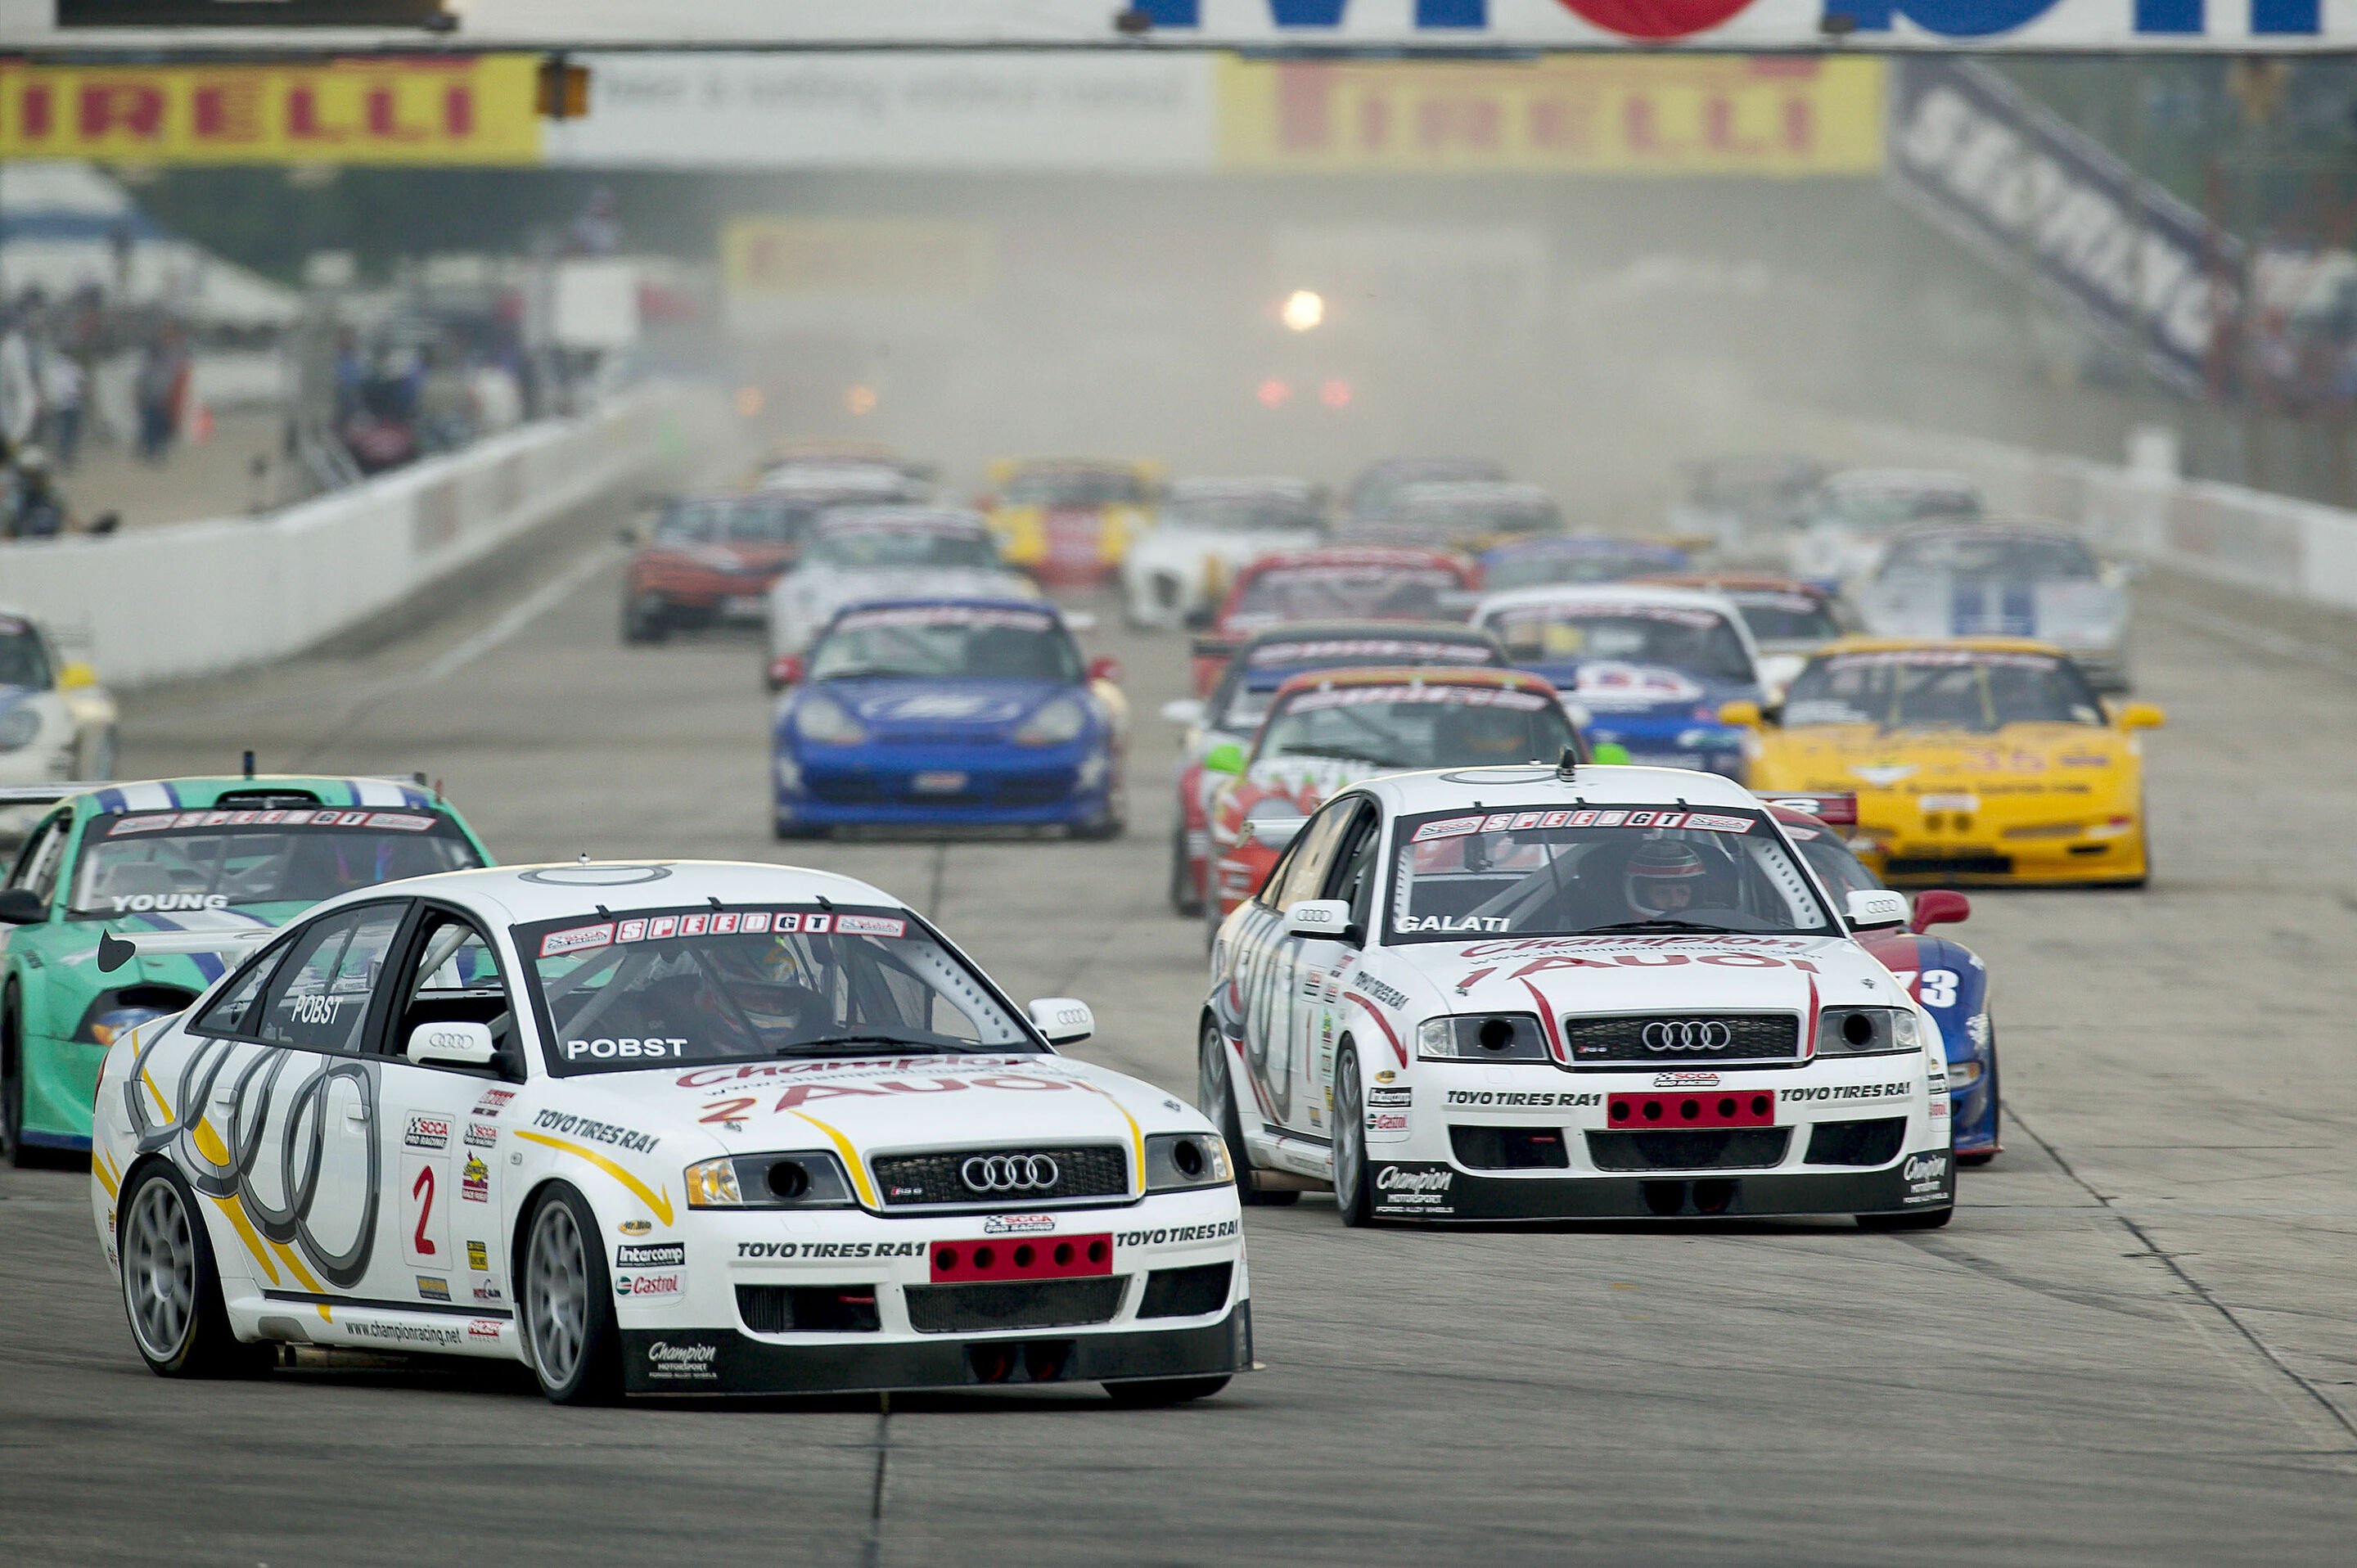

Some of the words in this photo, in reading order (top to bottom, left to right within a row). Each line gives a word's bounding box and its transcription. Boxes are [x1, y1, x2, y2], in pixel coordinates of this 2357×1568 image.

[1485, 811, 1626, 831] SPEED
[1631, 813, 1680, 827] GT
[110, 894, 230, 912] YOUNG
[619, 912, 769, 942] SPEED
[778, 916, 827, 930] GT
[1395, 915, 1510, 934] GALATI
[292, 994, 345, 1025] POBST
[566, 1037, 689, 1061] POBST
[1447, 1090, 1492, 1105] TOYO
[1496, 1092, 1554, 1106] TIRES
[1557, 1093, 1602, 1106] RA1
[1780, 1086, 1829, 1102] TOYO
[1833, 1083, 1881, 1099] TIRES
[1884, 1081, 1911, 1096] RA1
[698, 1097, 758, 1124] 2
[420, 1120, 448, 1136] SCCA
[533, 1108, 578, 1133] TOYO
[573, 1117, 625, 1144] TIRES
[620, 1130, 660, 1154] RA1
[1376, 1165, 1453, 1195] Champion
[412, 1165, 436, 1255] 2
[1003, 1215, 1052, 1223] SCCA
[1116, 1229, 1167, 1247] TOYO
[1169, 1223, 1216, 1242] TIRES
[1217, 1219, 1239, 1237] RA1
[620, 1246, 683, 1264] Intercomp
[737, 1241, 798, 1258] TOYO
[800, 1241, 872, 1258] TIRES
[873, 1241, 926, 1257] RA1
[633, 1274, 678, 1294] Castrol
[345, 1320, 462, 1346] www.championracing.net
[648, 1341, 717, 1365] Champion
